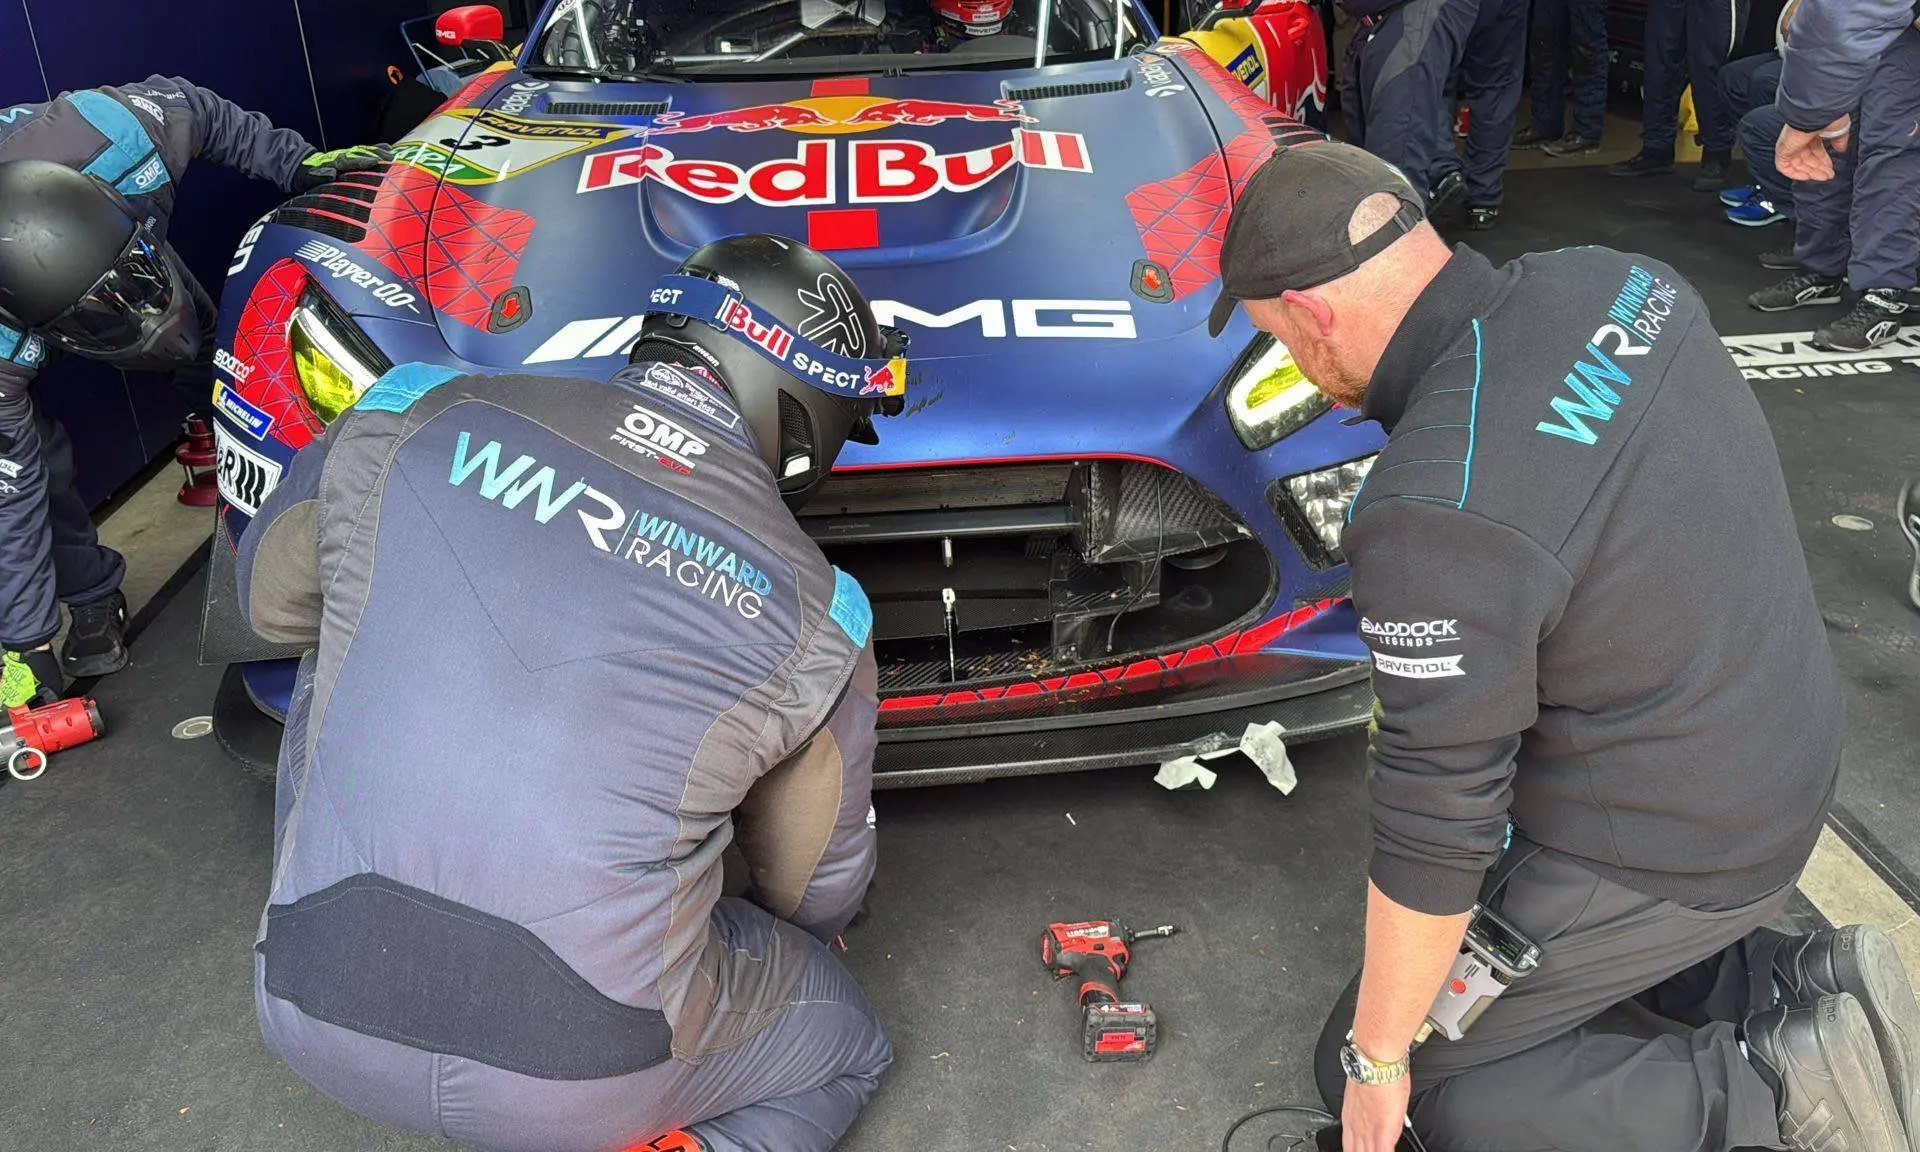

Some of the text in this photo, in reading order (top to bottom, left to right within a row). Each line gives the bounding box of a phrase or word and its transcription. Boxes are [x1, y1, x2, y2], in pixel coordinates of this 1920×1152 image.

[439, 134, 511, 150] 3
[481, 117, 601, 137] RAVENOL
[135, 161, 161, 186] OMP
[577, 127, 1094, 207] Red Bull
[312, 243, 384, 289] Player
[1608, 265, 1654, 325] WINWARD
[870, 298, 1138, 339] MG
[724, 297, 795, 362] Bull
[792, 351, 861, 390] SPECT
[213, 348, 252, 384] sparco
[1741, 361, 1893, 380] ACING
[225, 401, 264, 429] MICHELIN
[624, 412, 707, 457] OMP
[636, 511, 773, 597] WINWARD
[624, 536, 763, 620] RACING
[1379, 636, 1433, 648] LEGENDS
[1378, 657, 1452, 674] RAVENOL
